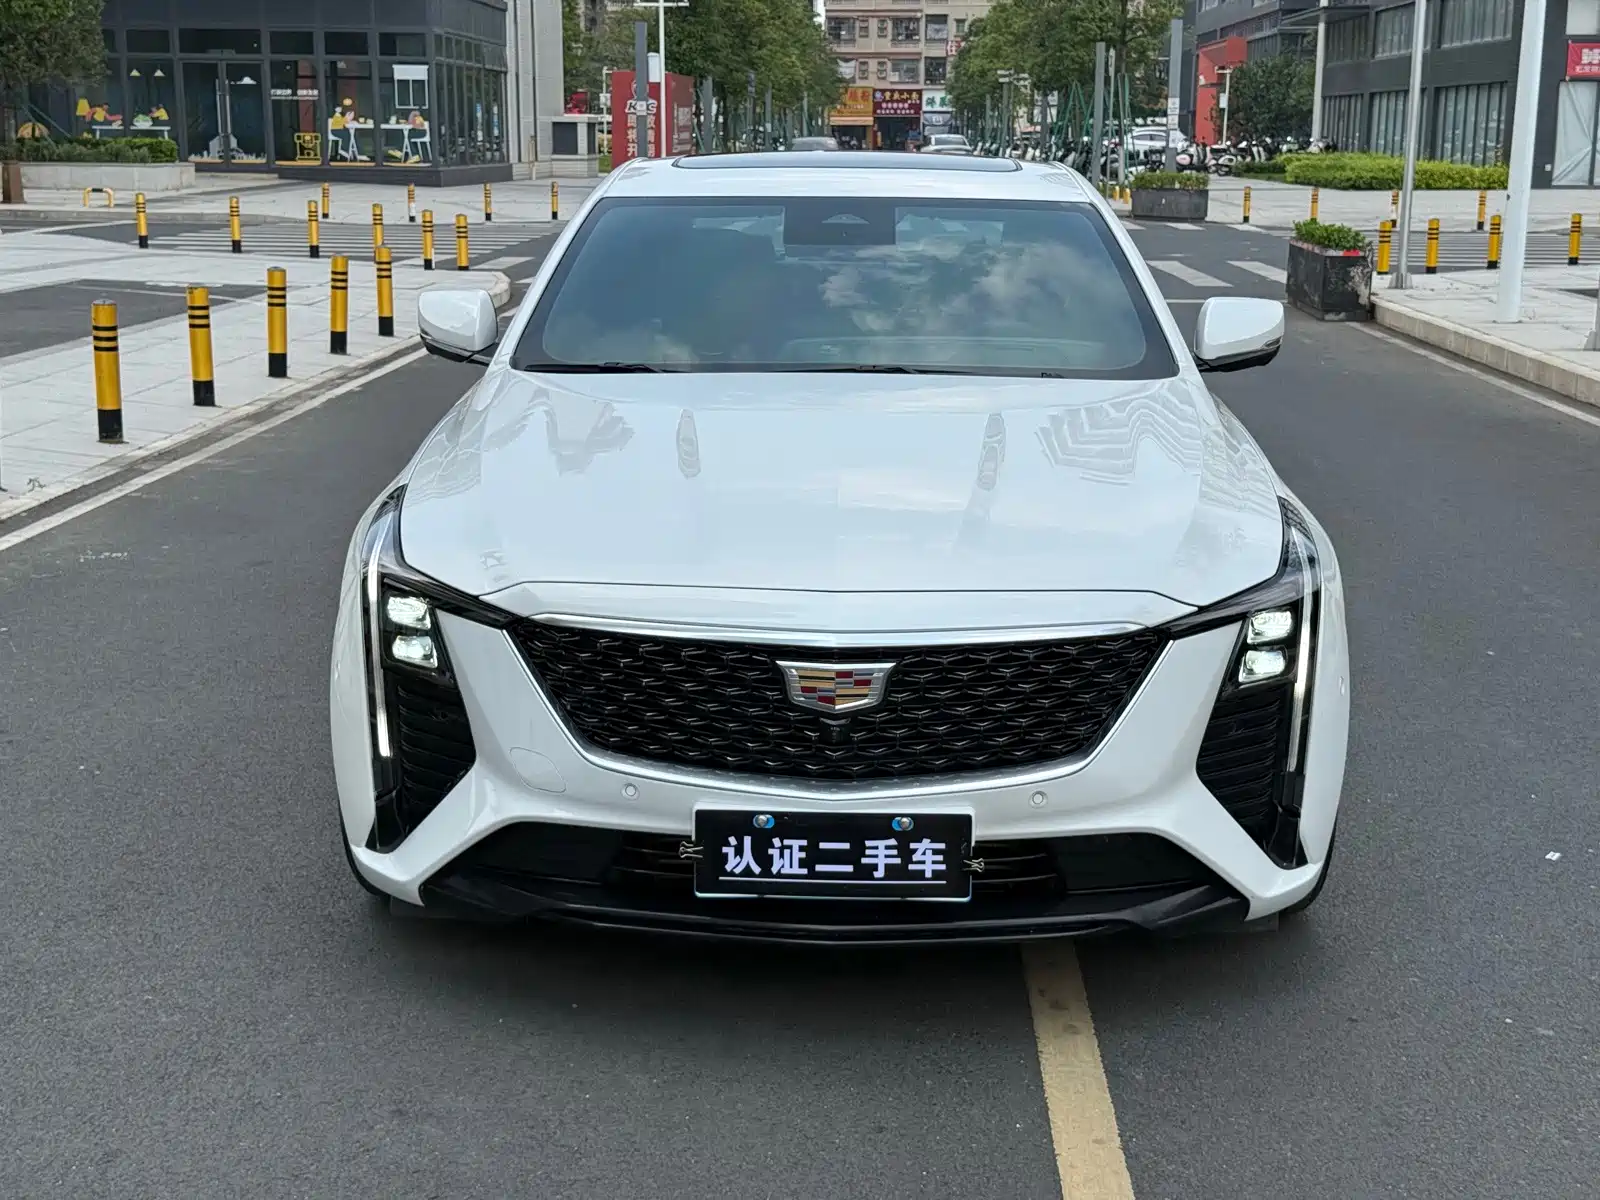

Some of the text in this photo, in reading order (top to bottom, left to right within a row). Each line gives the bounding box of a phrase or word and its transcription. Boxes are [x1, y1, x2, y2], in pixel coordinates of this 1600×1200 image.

[722, 836, 947, 878] 认证二手车
